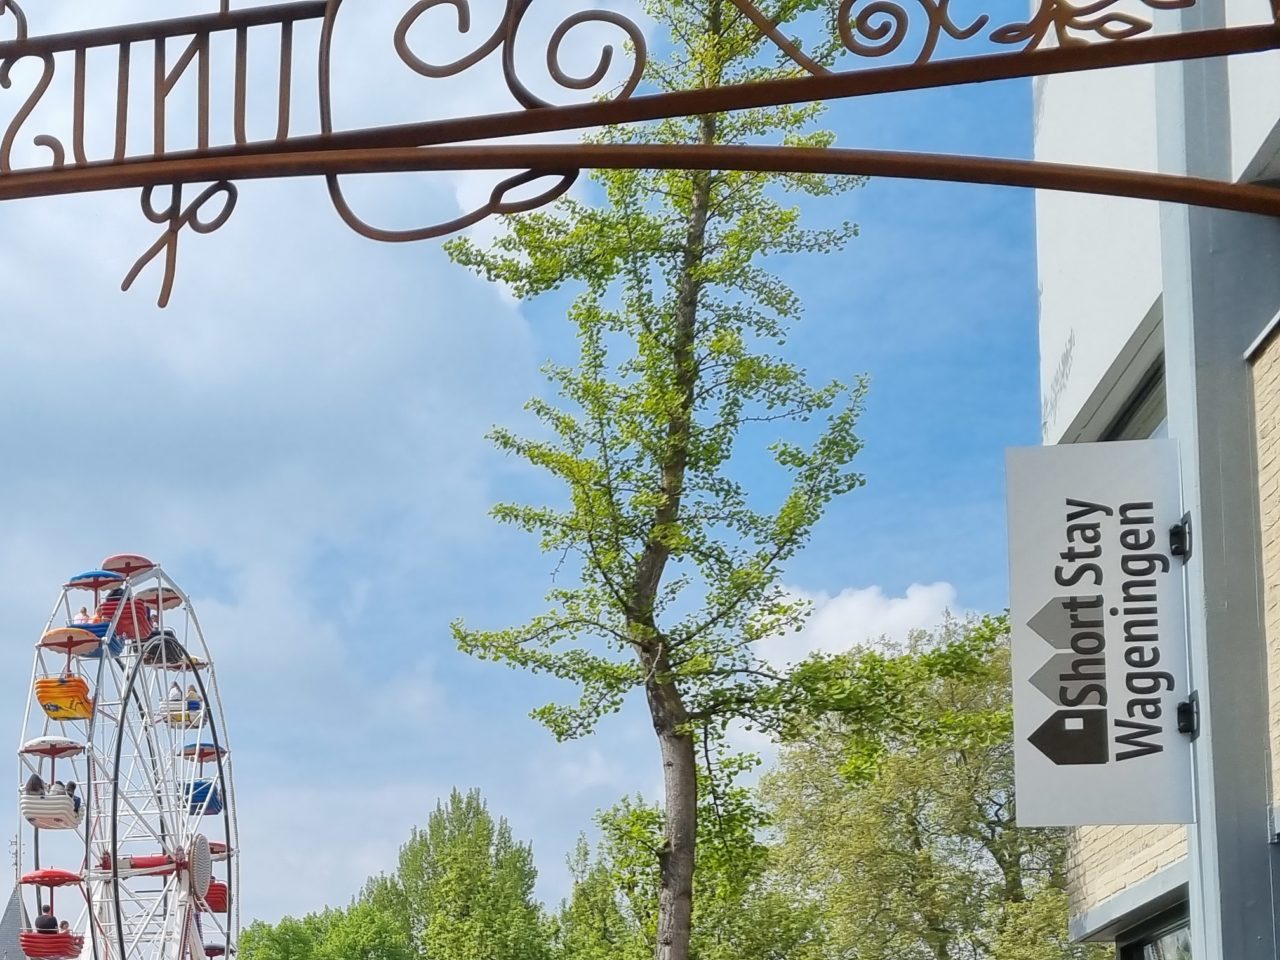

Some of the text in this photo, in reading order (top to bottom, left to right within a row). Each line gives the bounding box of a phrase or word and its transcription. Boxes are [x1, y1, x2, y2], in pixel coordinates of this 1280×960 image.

[1055, 498, 1113, 707] Short Stay
[1109, 501, 1175, 762] Wageningen
